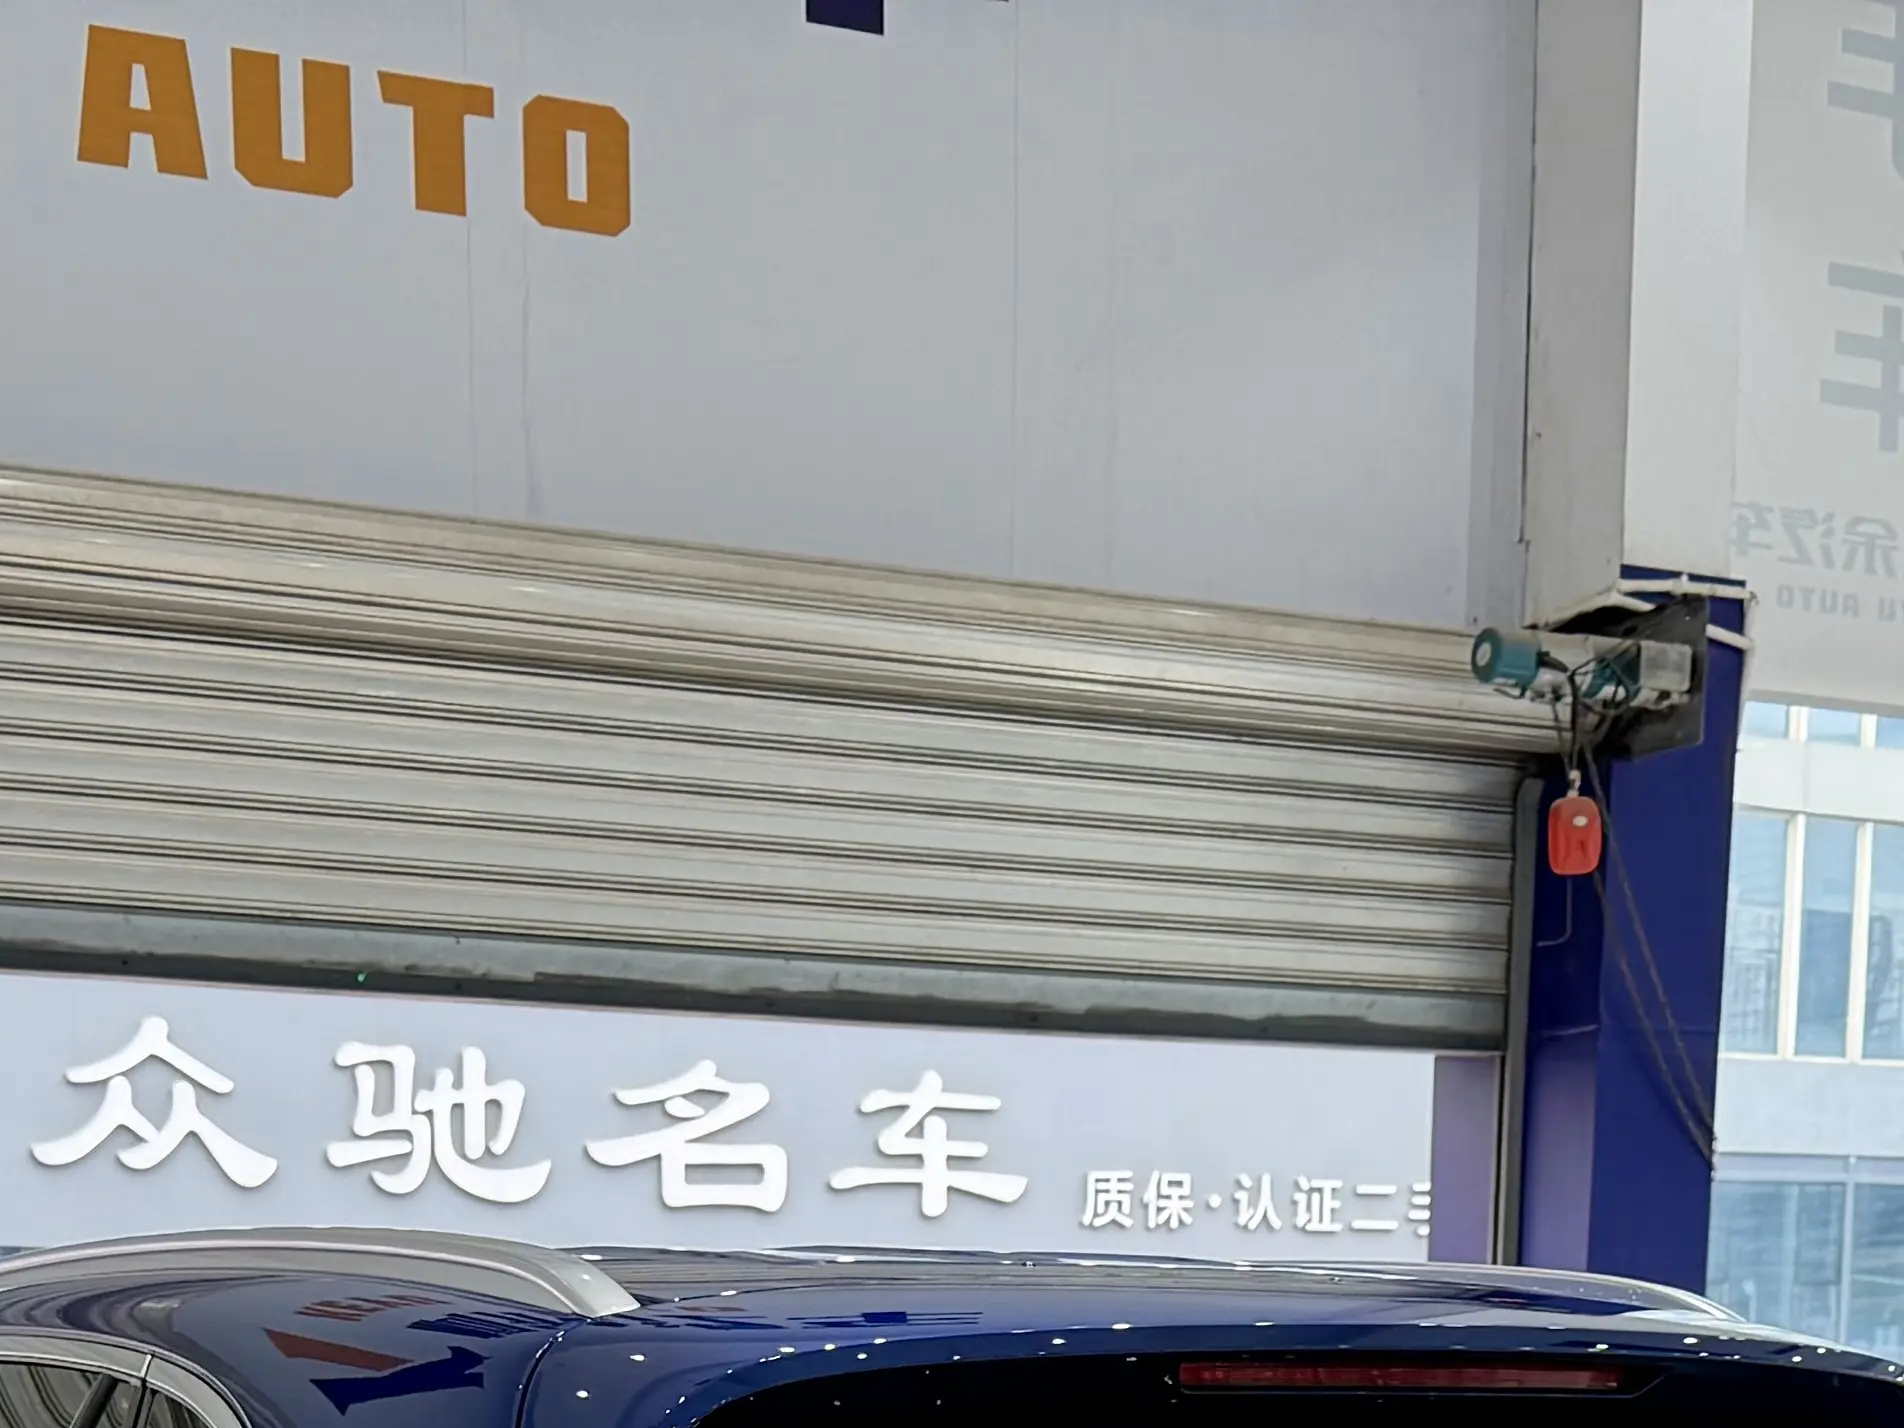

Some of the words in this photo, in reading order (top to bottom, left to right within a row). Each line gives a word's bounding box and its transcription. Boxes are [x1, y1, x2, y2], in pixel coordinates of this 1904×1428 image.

[77, 23, 631, 238] AUTO
[30, 1014, 1028, 1219] 众驰名车
